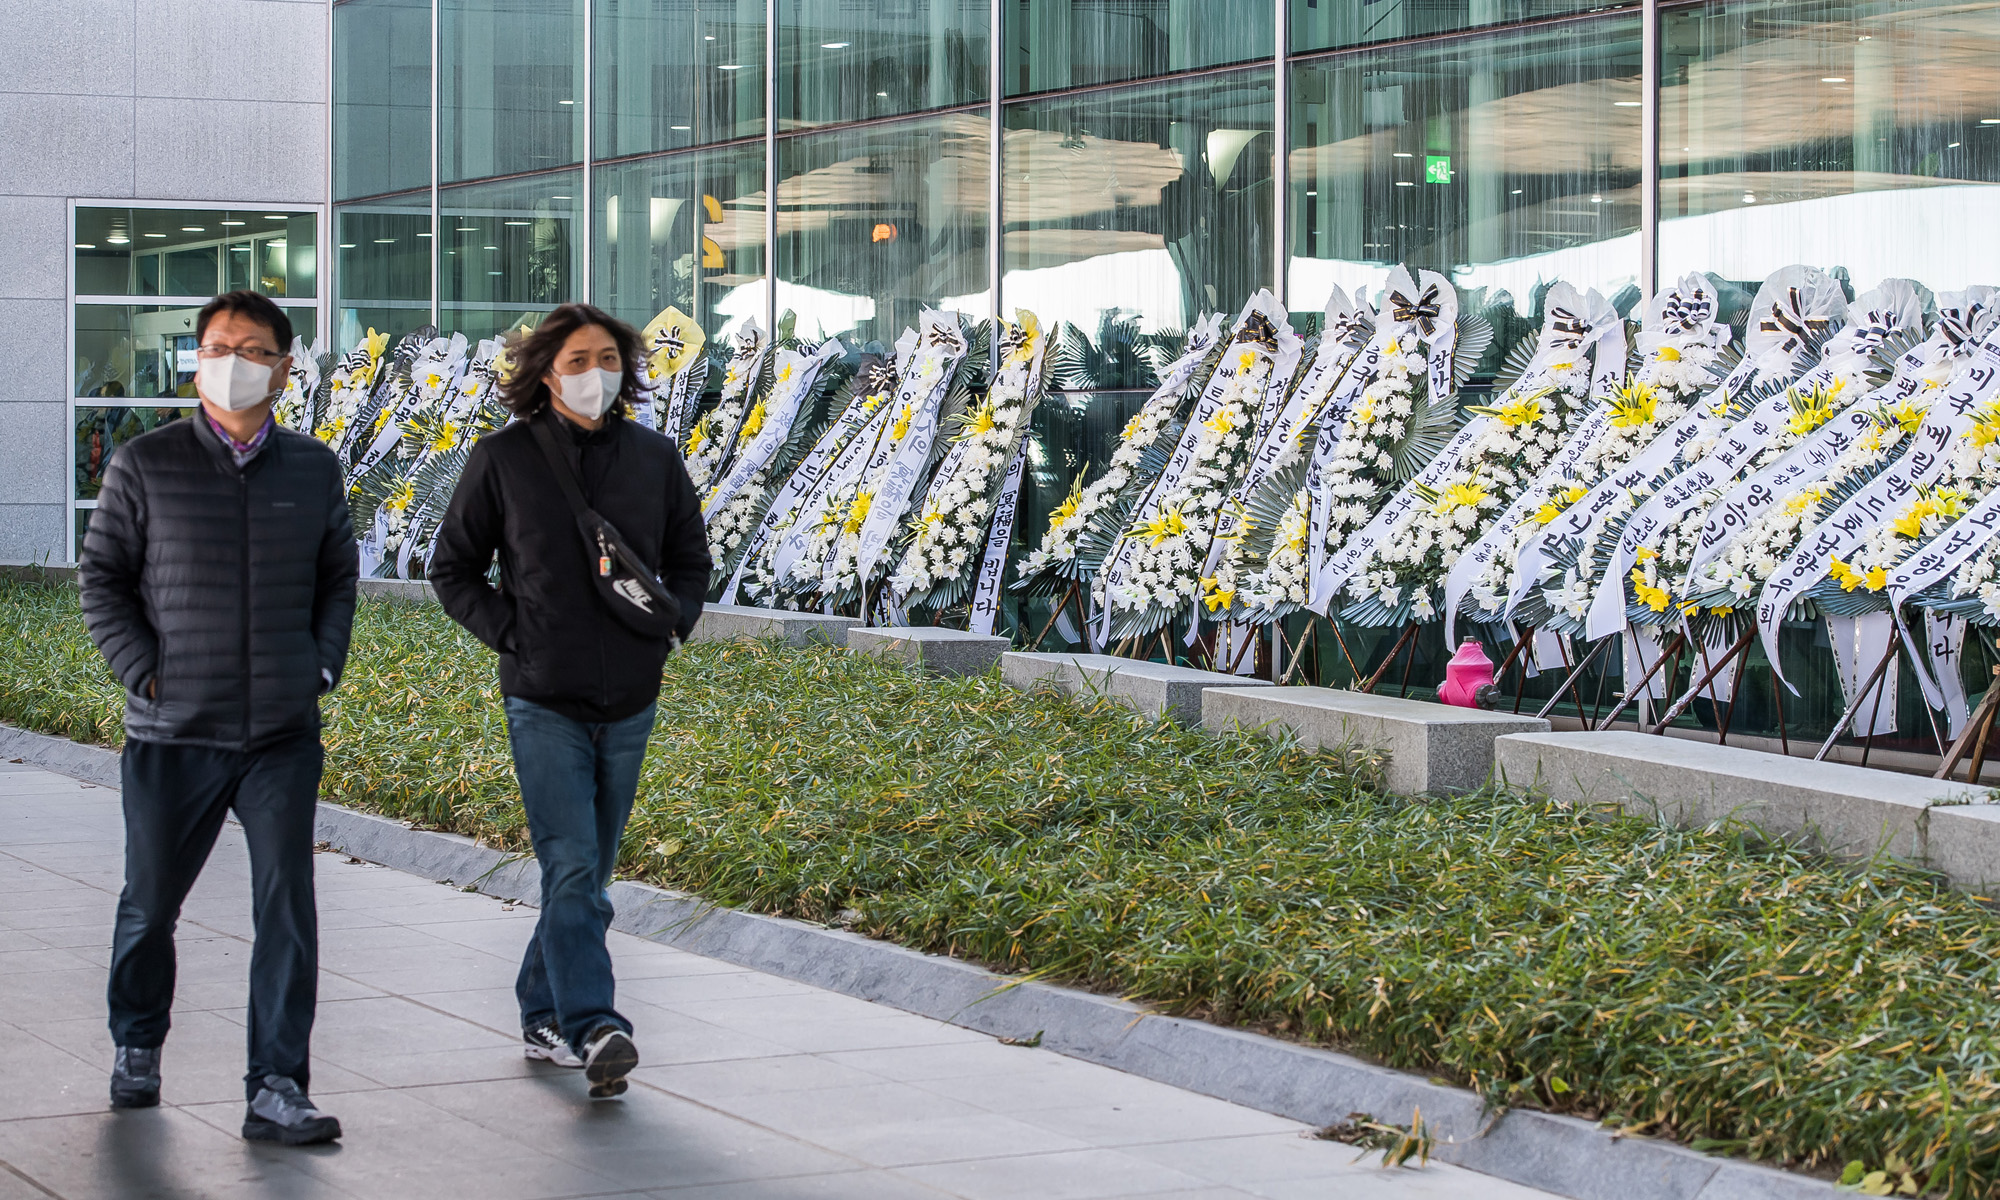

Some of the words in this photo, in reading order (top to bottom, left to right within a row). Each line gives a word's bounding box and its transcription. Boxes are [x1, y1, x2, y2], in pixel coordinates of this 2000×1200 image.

[674, 371, 688, 402] 삼가
[1949, 367, 1995, 416] 미국
[1384, 432, 1472, 525] 광주전남부장
[1773, 466, 1804, 485] 회장
[989, 490, 1018, 547] 冥福을
[1701, 484, 1774, 549] 양승길
[622, 579, 652, 603] NIKE
[975, 557, 999, 617] 빕니다
